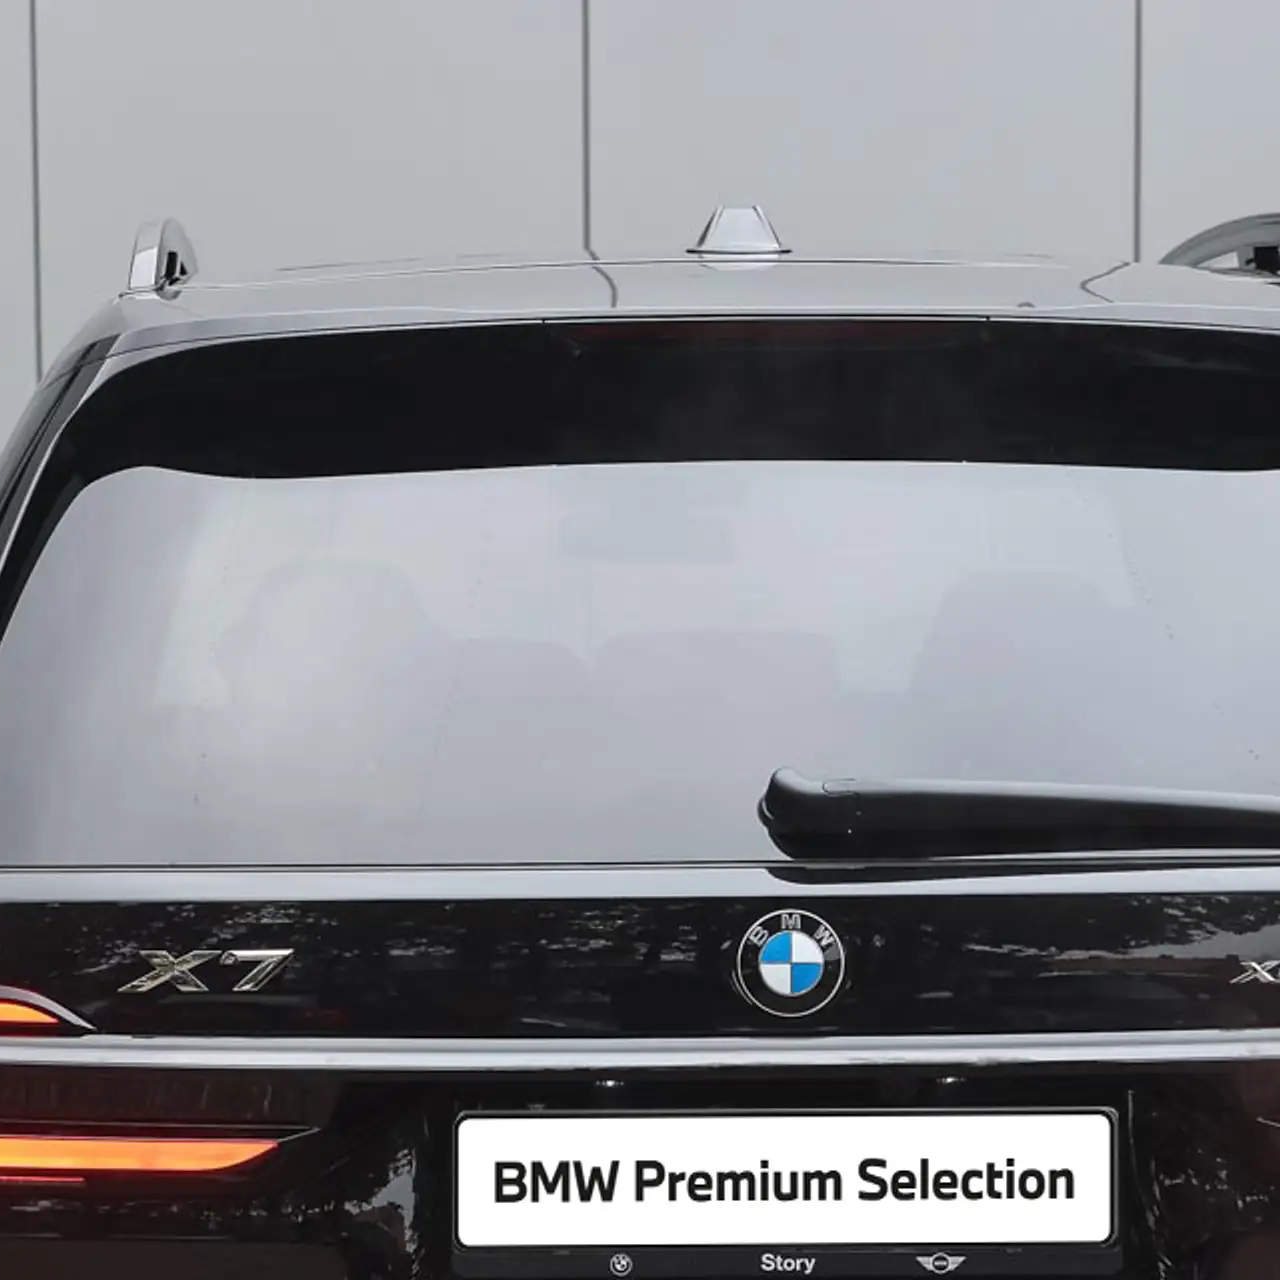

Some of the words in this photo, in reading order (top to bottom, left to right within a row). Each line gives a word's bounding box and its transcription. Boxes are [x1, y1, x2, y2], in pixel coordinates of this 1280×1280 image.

[749, 913, 835, 948] BMW
[117, 948, 295, 992] X7
[495, 1160, 620, 1203] BMW
[635, 1159, 842, 1202] Premium
[858, 1158, 1074, 1201] Selection
[760, 1252, 817, 1275] Story
